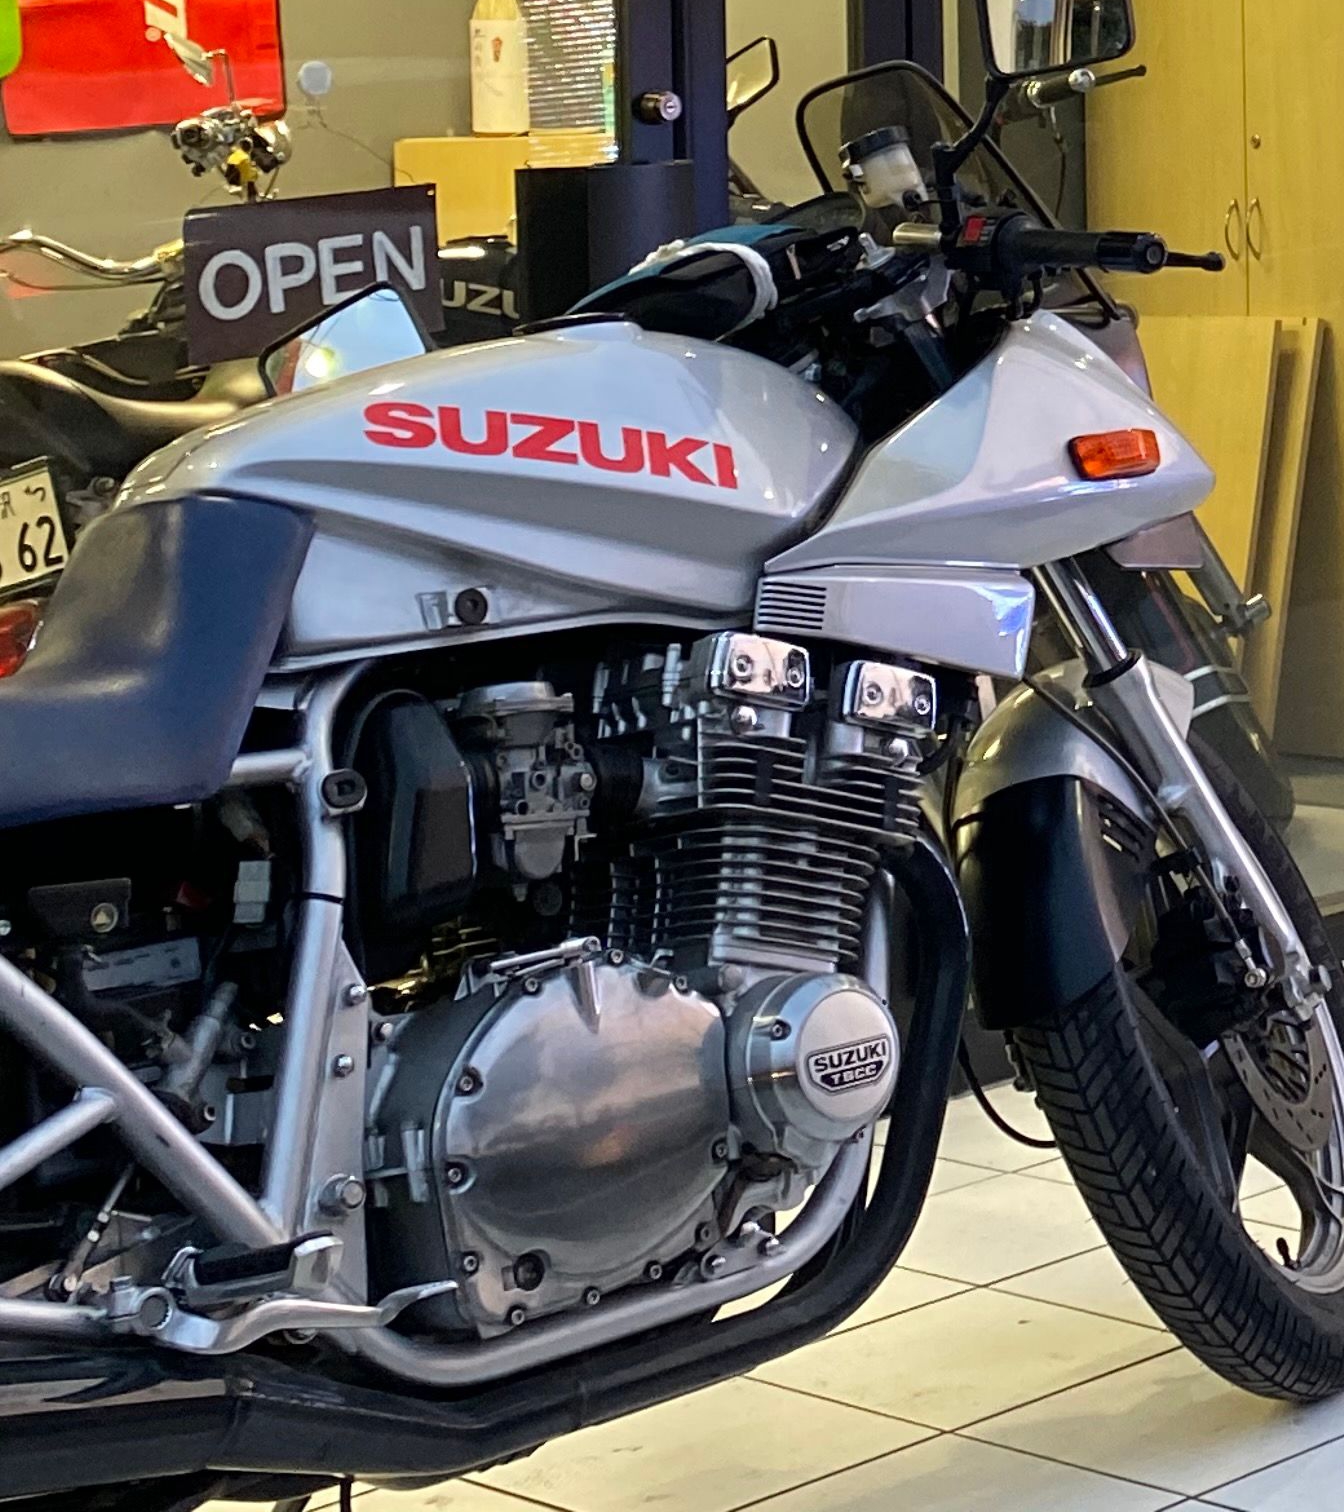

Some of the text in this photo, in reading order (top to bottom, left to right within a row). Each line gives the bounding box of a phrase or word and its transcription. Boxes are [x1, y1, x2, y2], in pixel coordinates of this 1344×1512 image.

[198, 225, 427, 321] OPEN
[363, 401, 739, 490] SUZUKI
[813, 1041, 887, 1073] SUZUKI
